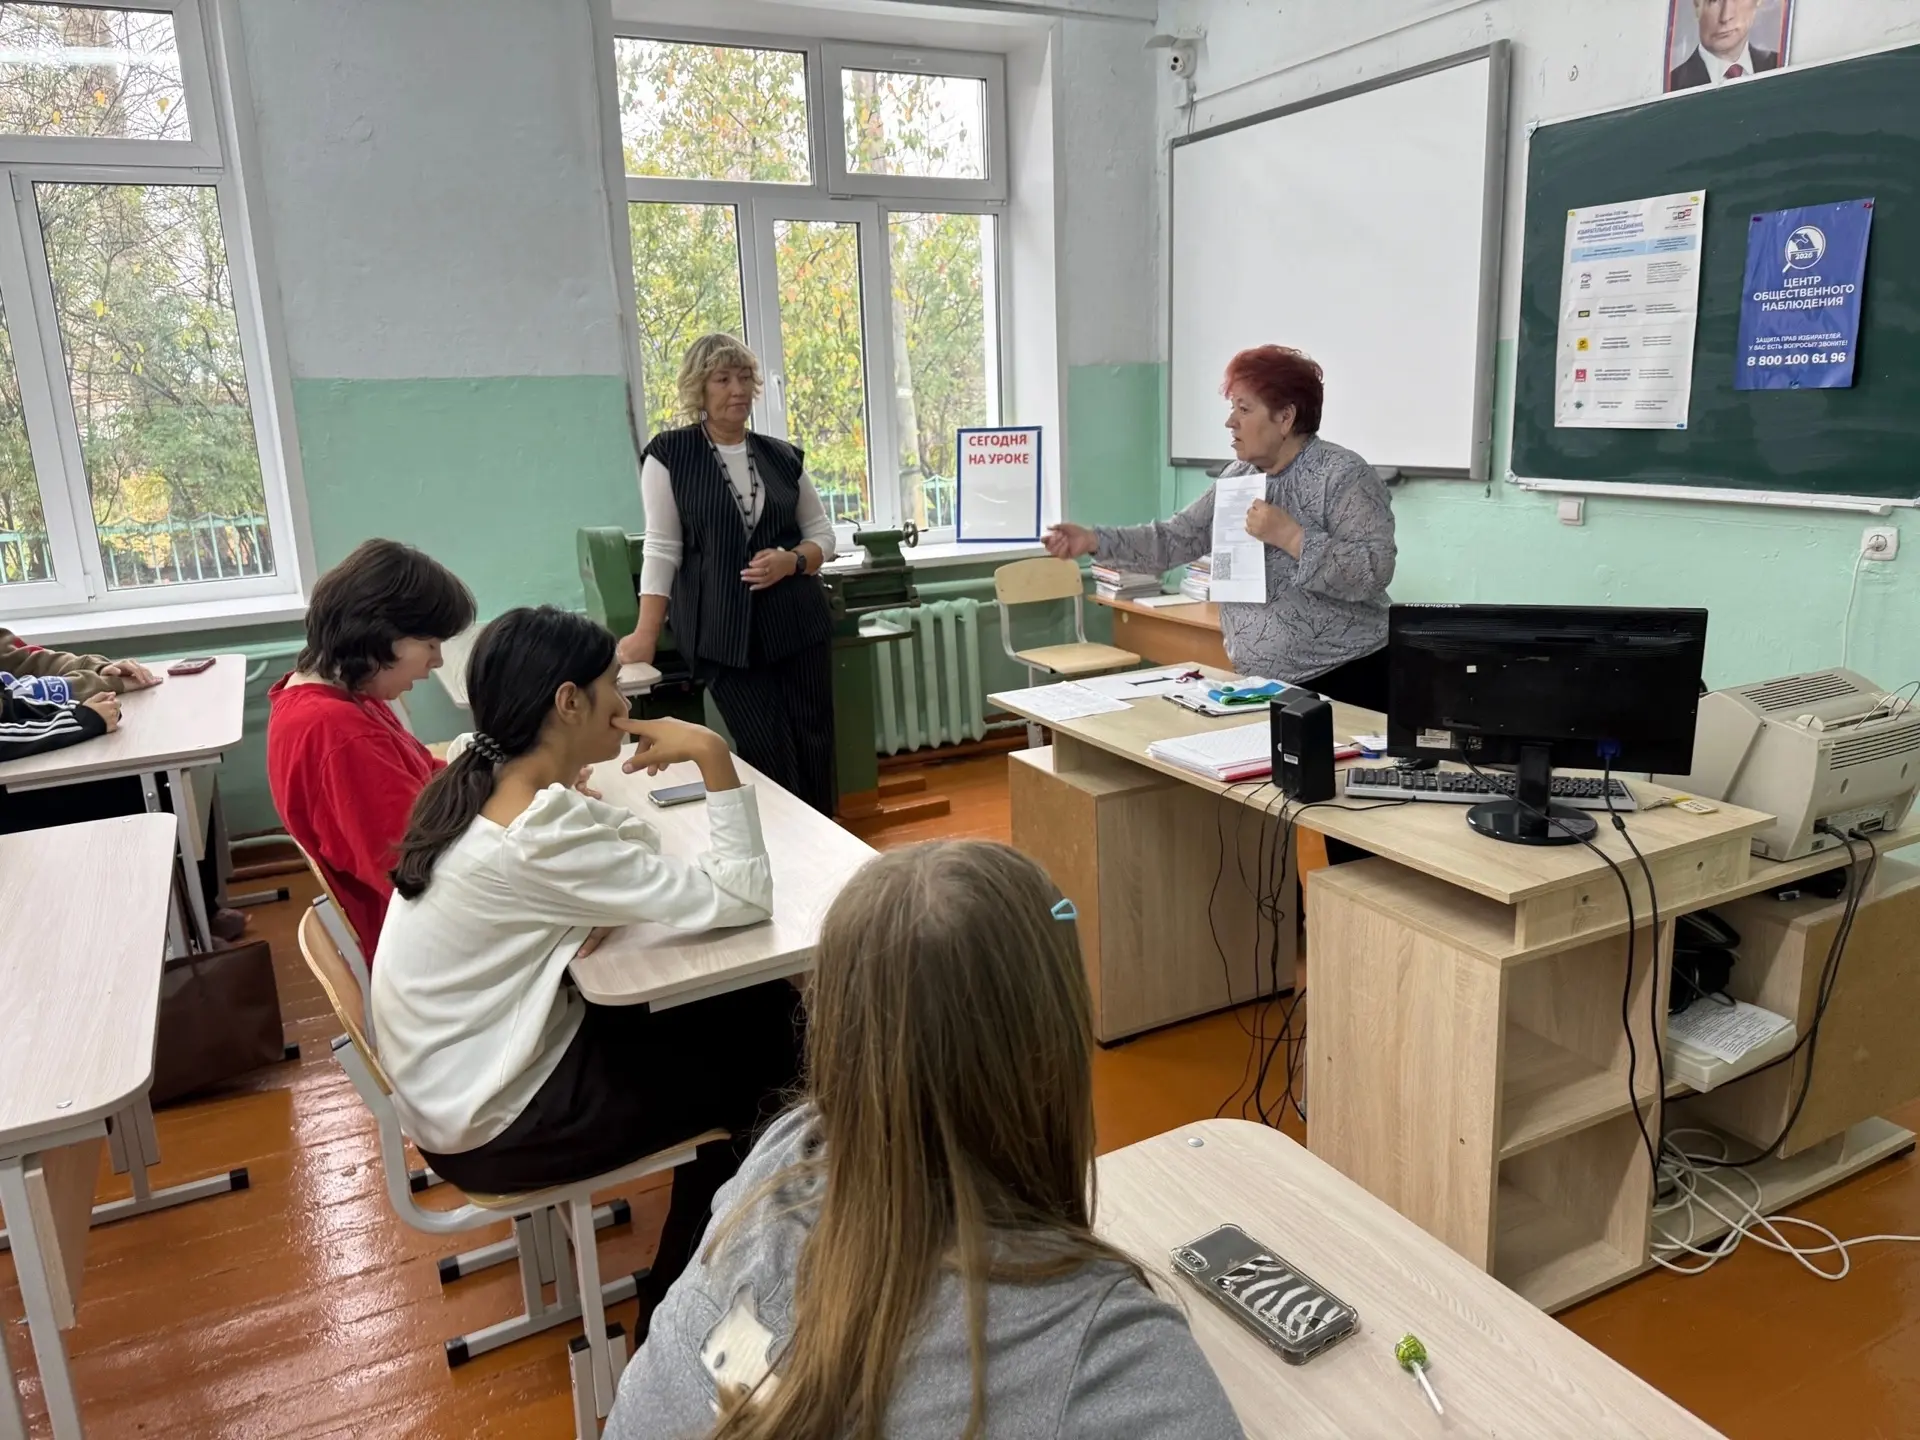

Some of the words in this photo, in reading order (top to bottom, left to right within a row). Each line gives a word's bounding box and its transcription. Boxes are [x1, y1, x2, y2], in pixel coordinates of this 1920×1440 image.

[1794, 252, 1813, 260] 2026
[1783, 275, 1822, 288] ЦЕНТР
[1753, 284, 1855, 301] ОБЩЕСТВЕННОГО
[1761, 296, 1844, 312] НАБЛЮДЕНИЯ
[1818, 340, 1848, 348] ЗВОНИТЕ!
[1747, 356, 1756, 366] 8
[1758, 355, 1782, 366] 800
[1784, 354, 1809, 365] 100
[1811, 353, 1828, 364] 61
[1830, 352, 1846, 363] 96
[969, 434, 1027, 448] СЕГОДНЯ
[969, 454, 985, 465] НА
[988, 453, 1029, 465] УРОКЕ
